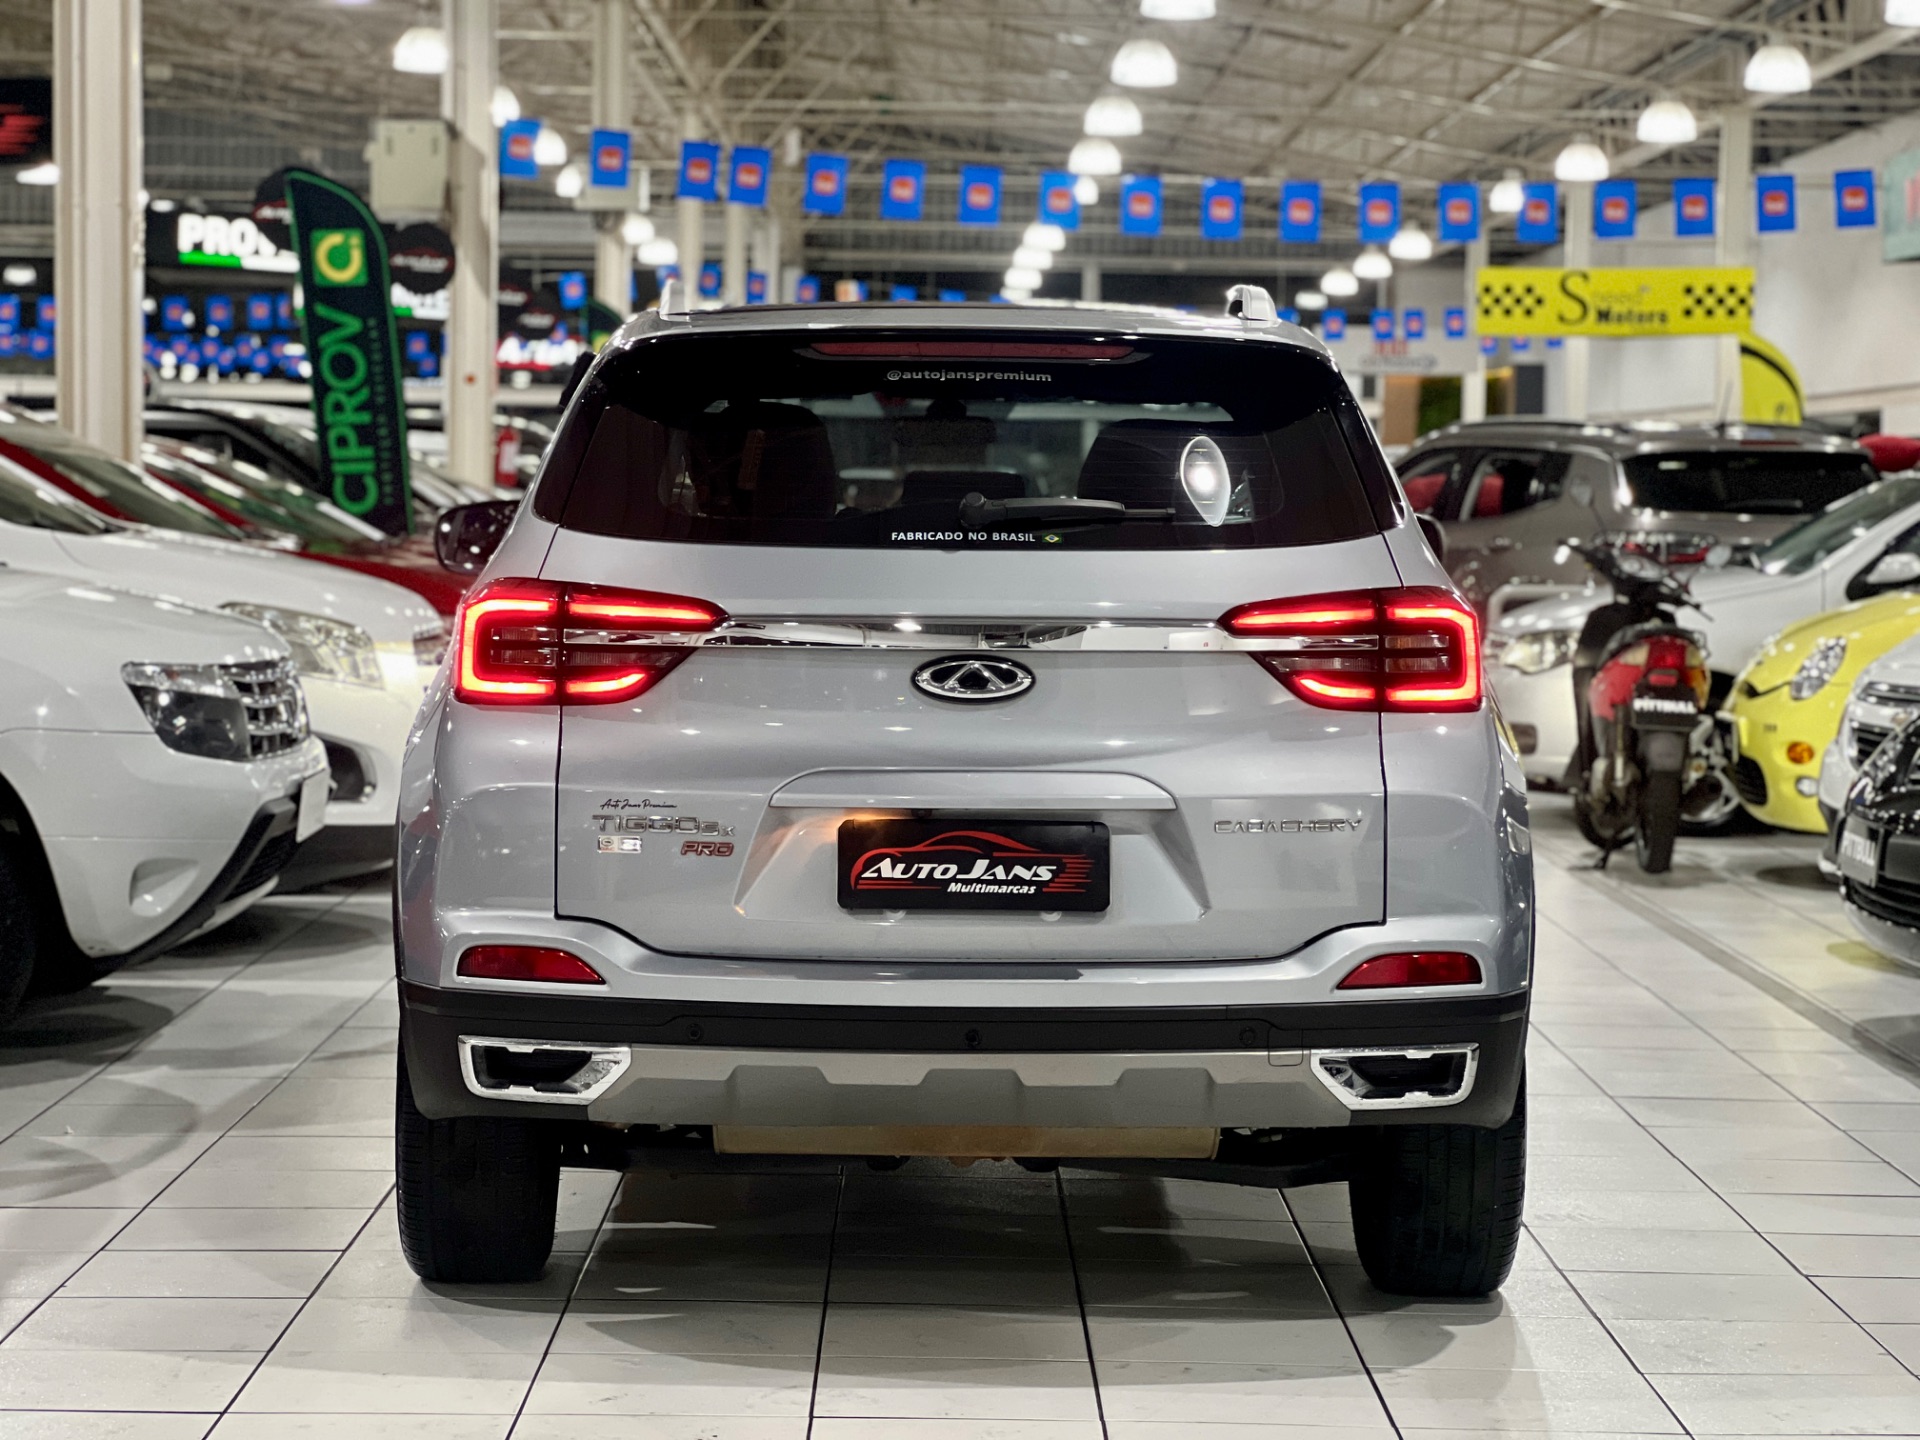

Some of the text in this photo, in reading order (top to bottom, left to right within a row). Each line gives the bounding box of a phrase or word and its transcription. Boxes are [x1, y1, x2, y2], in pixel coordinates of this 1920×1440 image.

[886, 369, 1052, 382] @autojanspremium
[314, 302, 380, 515] CIPROV
[891, 531, 1036, 542] FABRICADO NO BRASIL
[681, 840, 735, 857] PRO
[947, 881, 1037, 895] Multimarcas
